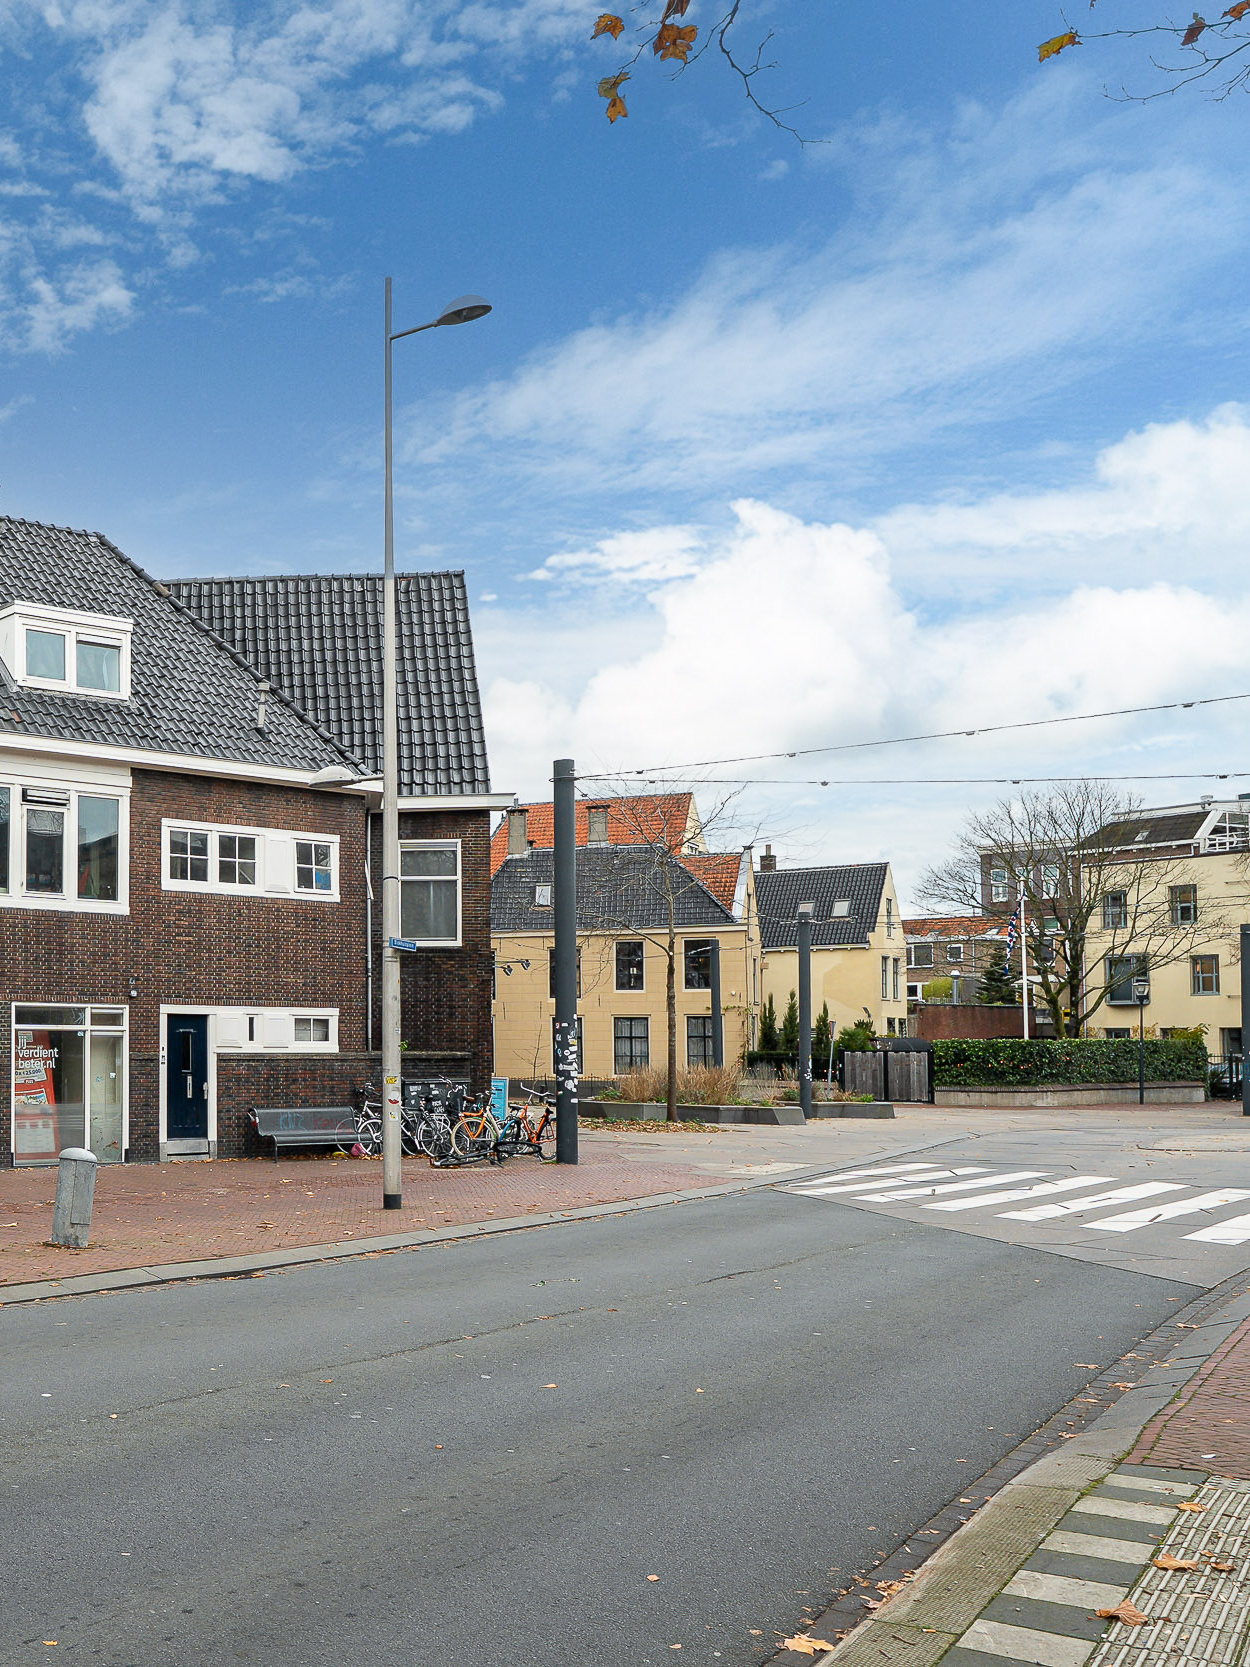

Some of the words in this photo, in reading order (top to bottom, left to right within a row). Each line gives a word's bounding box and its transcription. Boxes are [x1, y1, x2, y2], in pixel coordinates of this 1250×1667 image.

[18, 1036, 27, 1049] jij
[18, 1047, 58, 1057] verdient
[18, 1058, 56, 1069] beter.nl
